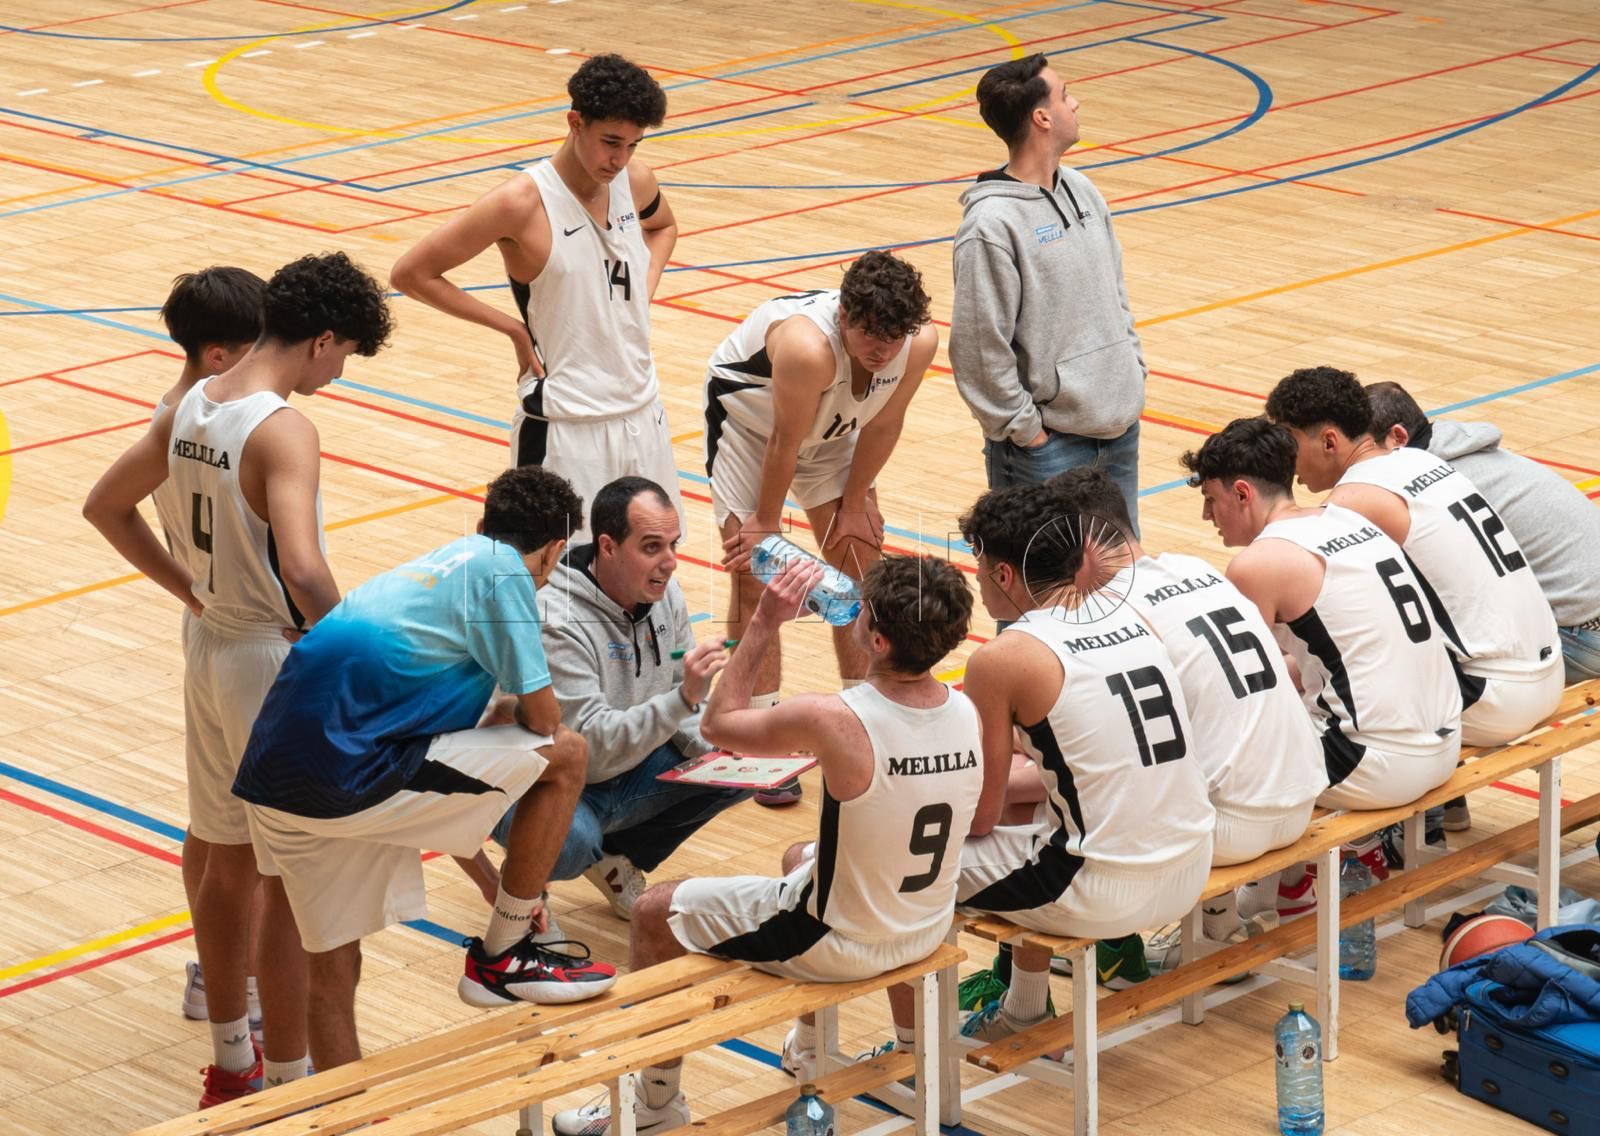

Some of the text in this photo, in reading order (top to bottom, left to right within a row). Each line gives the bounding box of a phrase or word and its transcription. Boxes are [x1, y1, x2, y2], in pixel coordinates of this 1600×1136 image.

[604, 259, 631, 302] 14
[173, 437, 231, 470] MELILLA
[191, 492, 215, 595] 4
[1317, 526, 1383, 557] MELILLA
[1447, 492, 1527, 578] 12
[1144, 573, 1224, 606] MELILLA
[1375, 557, 1432, 644] 6
[1063, 623, 1150, 654] MELILLA
[1185, 606, 1278, 700] 15
[1105, 665, 1187, 768] 13
[888, 749, 978, 776] MELILLA
[898, 802, 953, 894] 9
